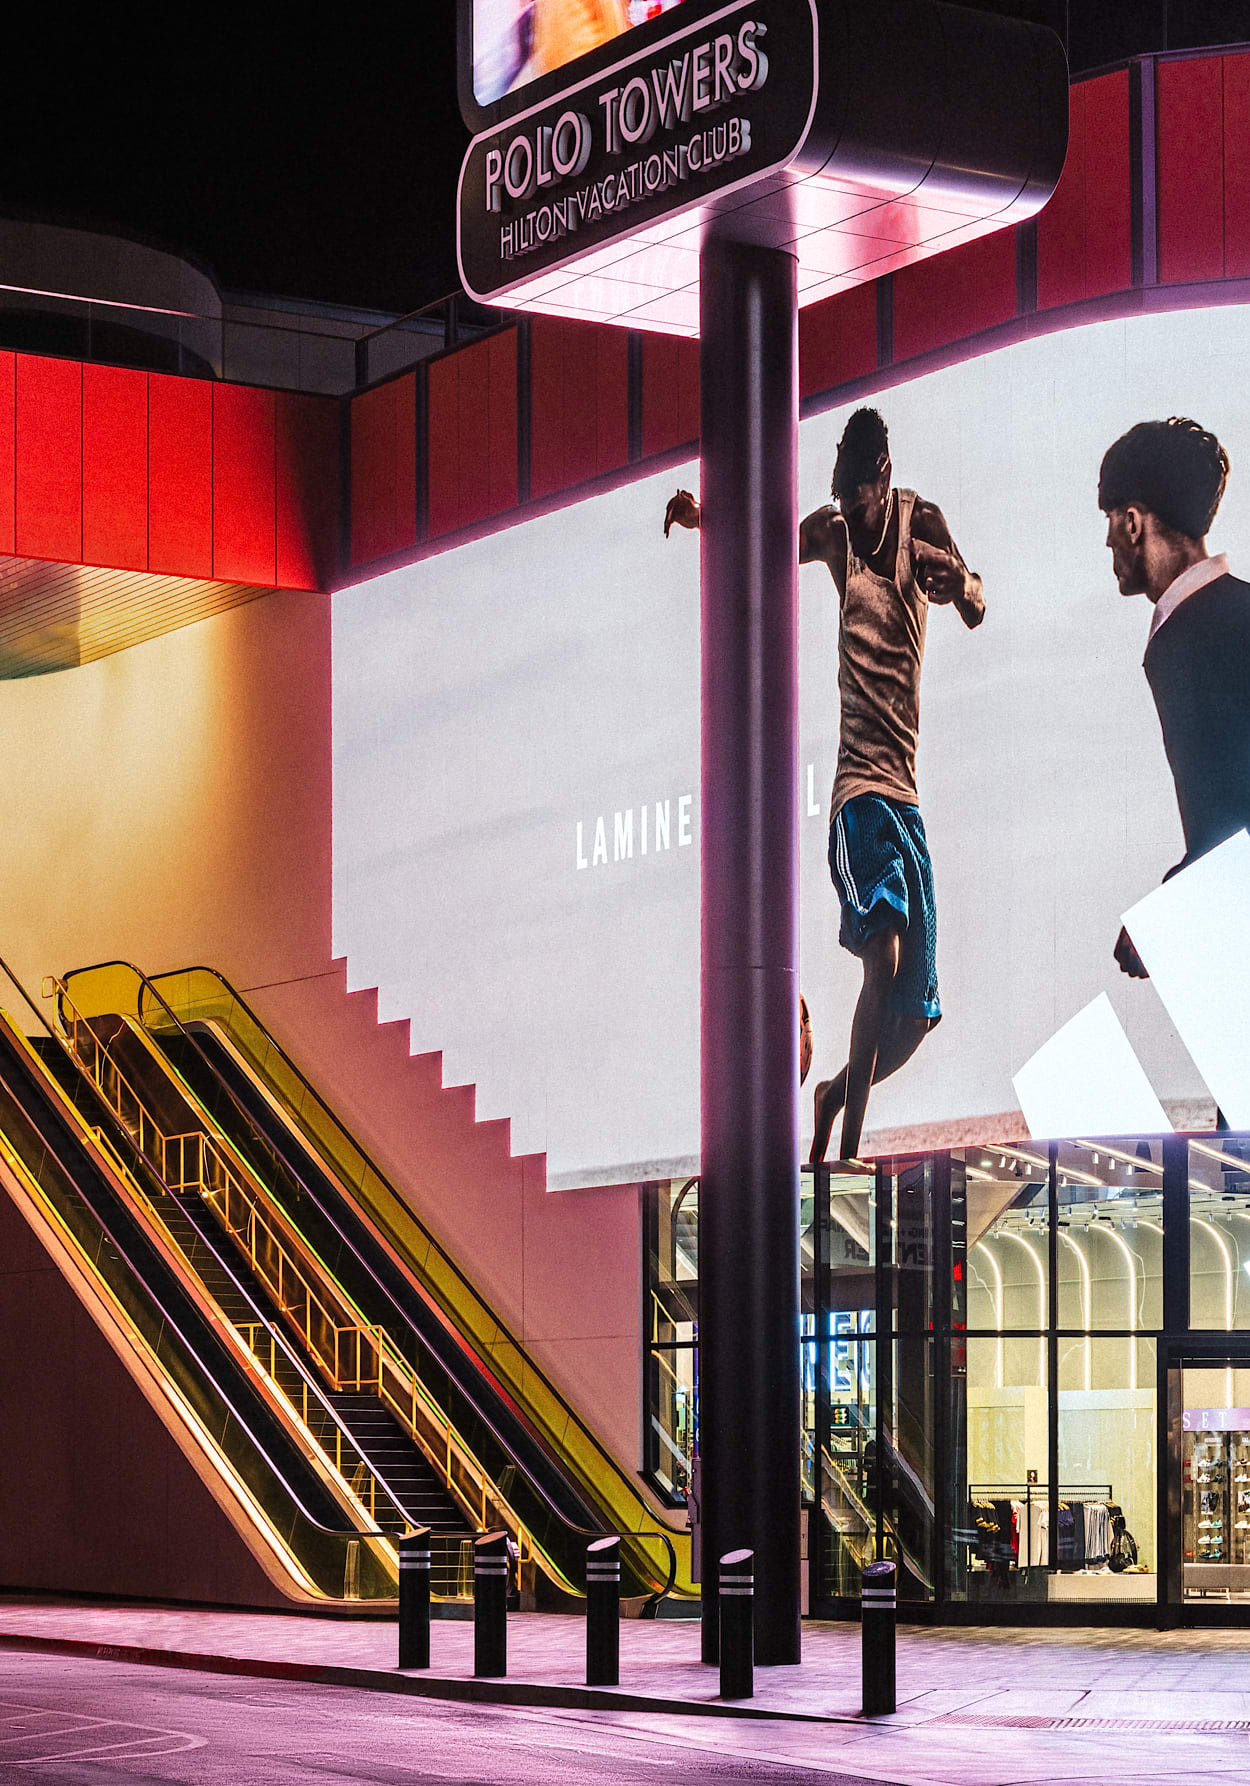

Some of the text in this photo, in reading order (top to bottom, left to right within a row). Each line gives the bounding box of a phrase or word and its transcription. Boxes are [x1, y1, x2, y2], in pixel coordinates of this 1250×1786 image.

[486, 20, 768, 212] POLO TOWERS
[501, 117, 751, 260] HILTON VACATION CLUB
[576, 794, 693, 870] LAMINE
